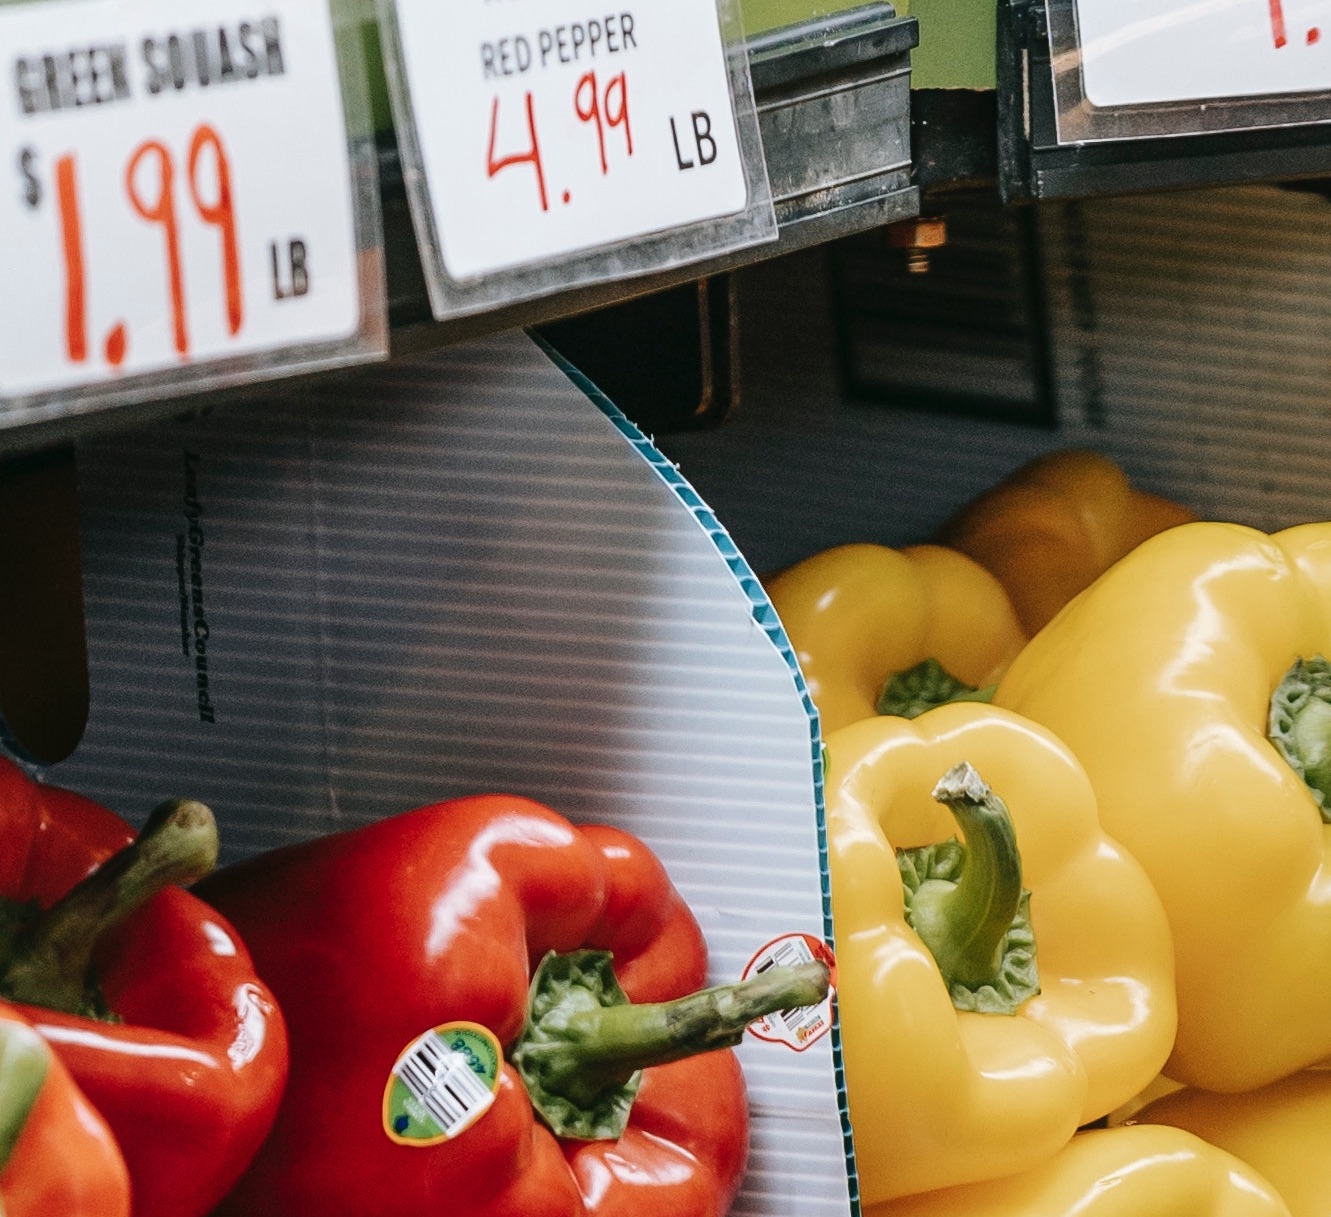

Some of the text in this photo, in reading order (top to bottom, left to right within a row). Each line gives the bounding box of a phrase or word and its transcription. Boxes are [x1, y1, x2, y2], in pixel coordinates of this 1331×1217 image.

[16, 15, 286, 114] GREEN SQUASH
[481, 13, 638, 79] RED PEPPER
[487, 69, 718, 211] 4.99 LB
[269, 237, 311, 301] LB
